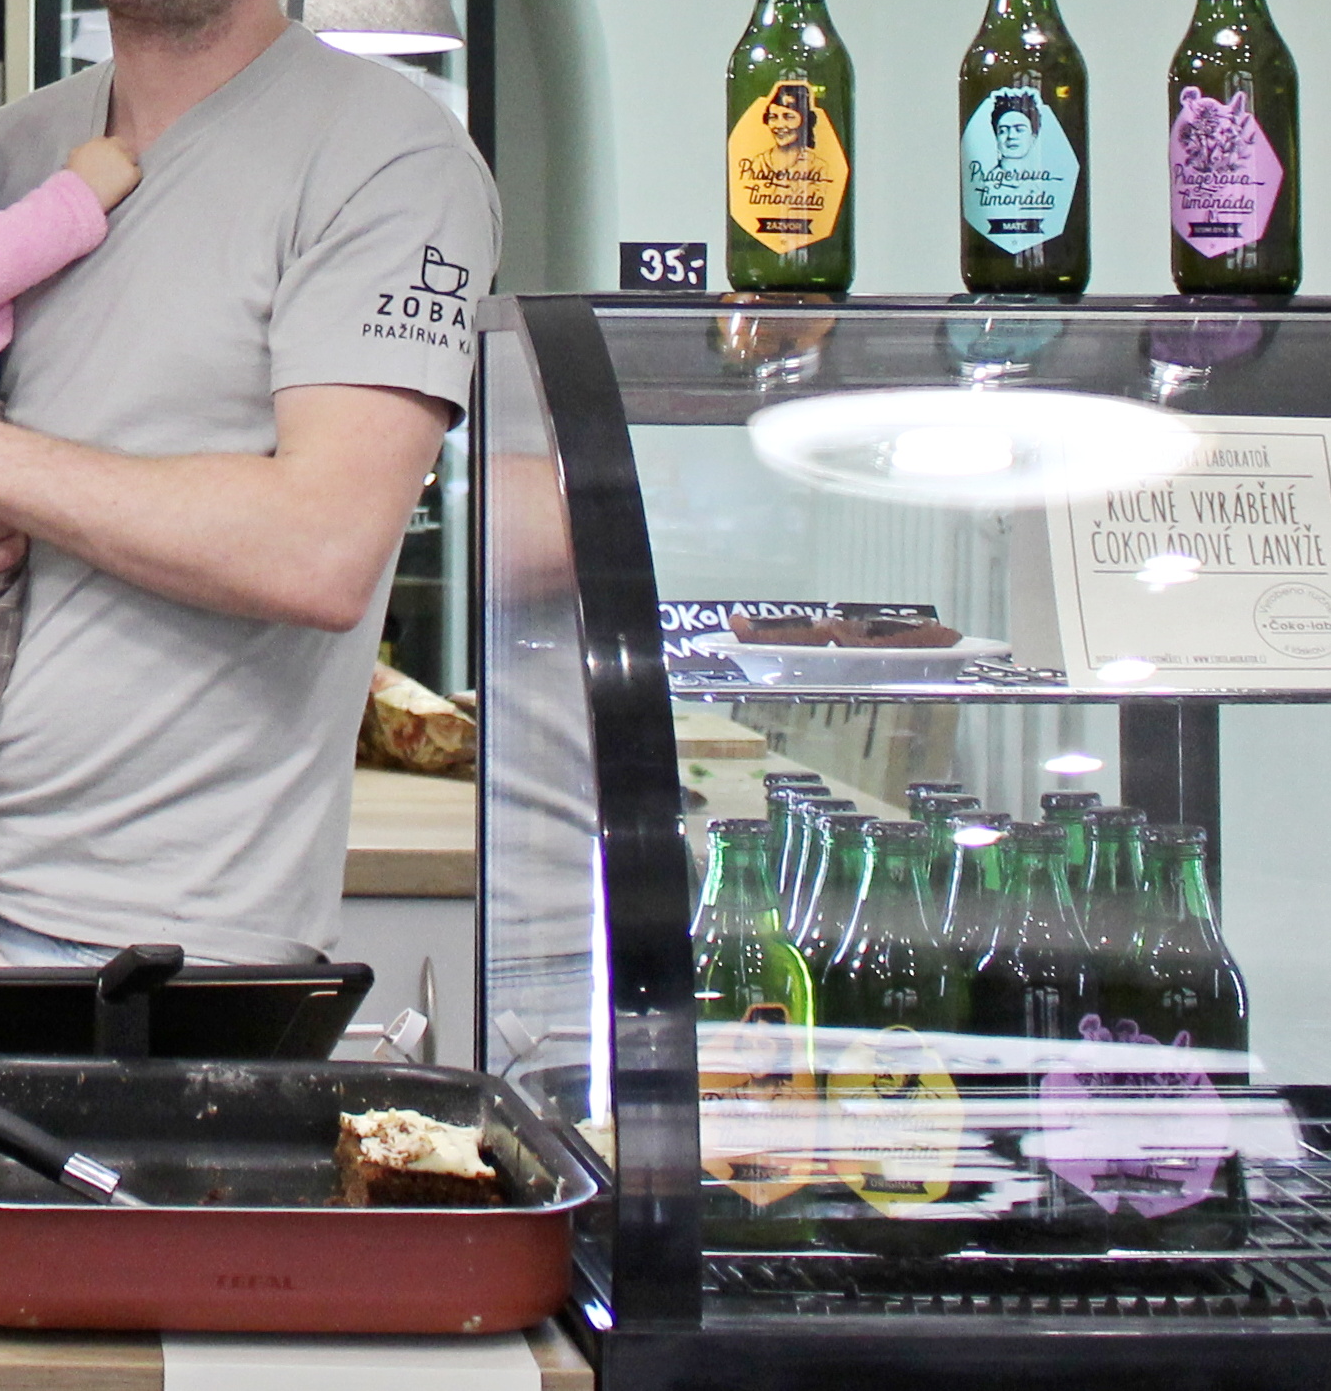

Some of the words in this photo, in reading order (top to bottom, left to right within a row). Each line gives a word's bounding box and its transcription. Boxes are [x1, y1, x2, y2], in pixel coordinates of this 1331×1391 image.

[377, 293, 474, 333] ZOBA
[362, 322, 449, 349] PRAŽÍRNA
[1205, 445, 1272, 469] LABORATOŘ
[1107, 480, 1180, 524] RUČNĚ
[1190, 482, 1301, 525] VYRÁBĚNÉ
[1247, 524, 1327, 567] LANÝŽE
